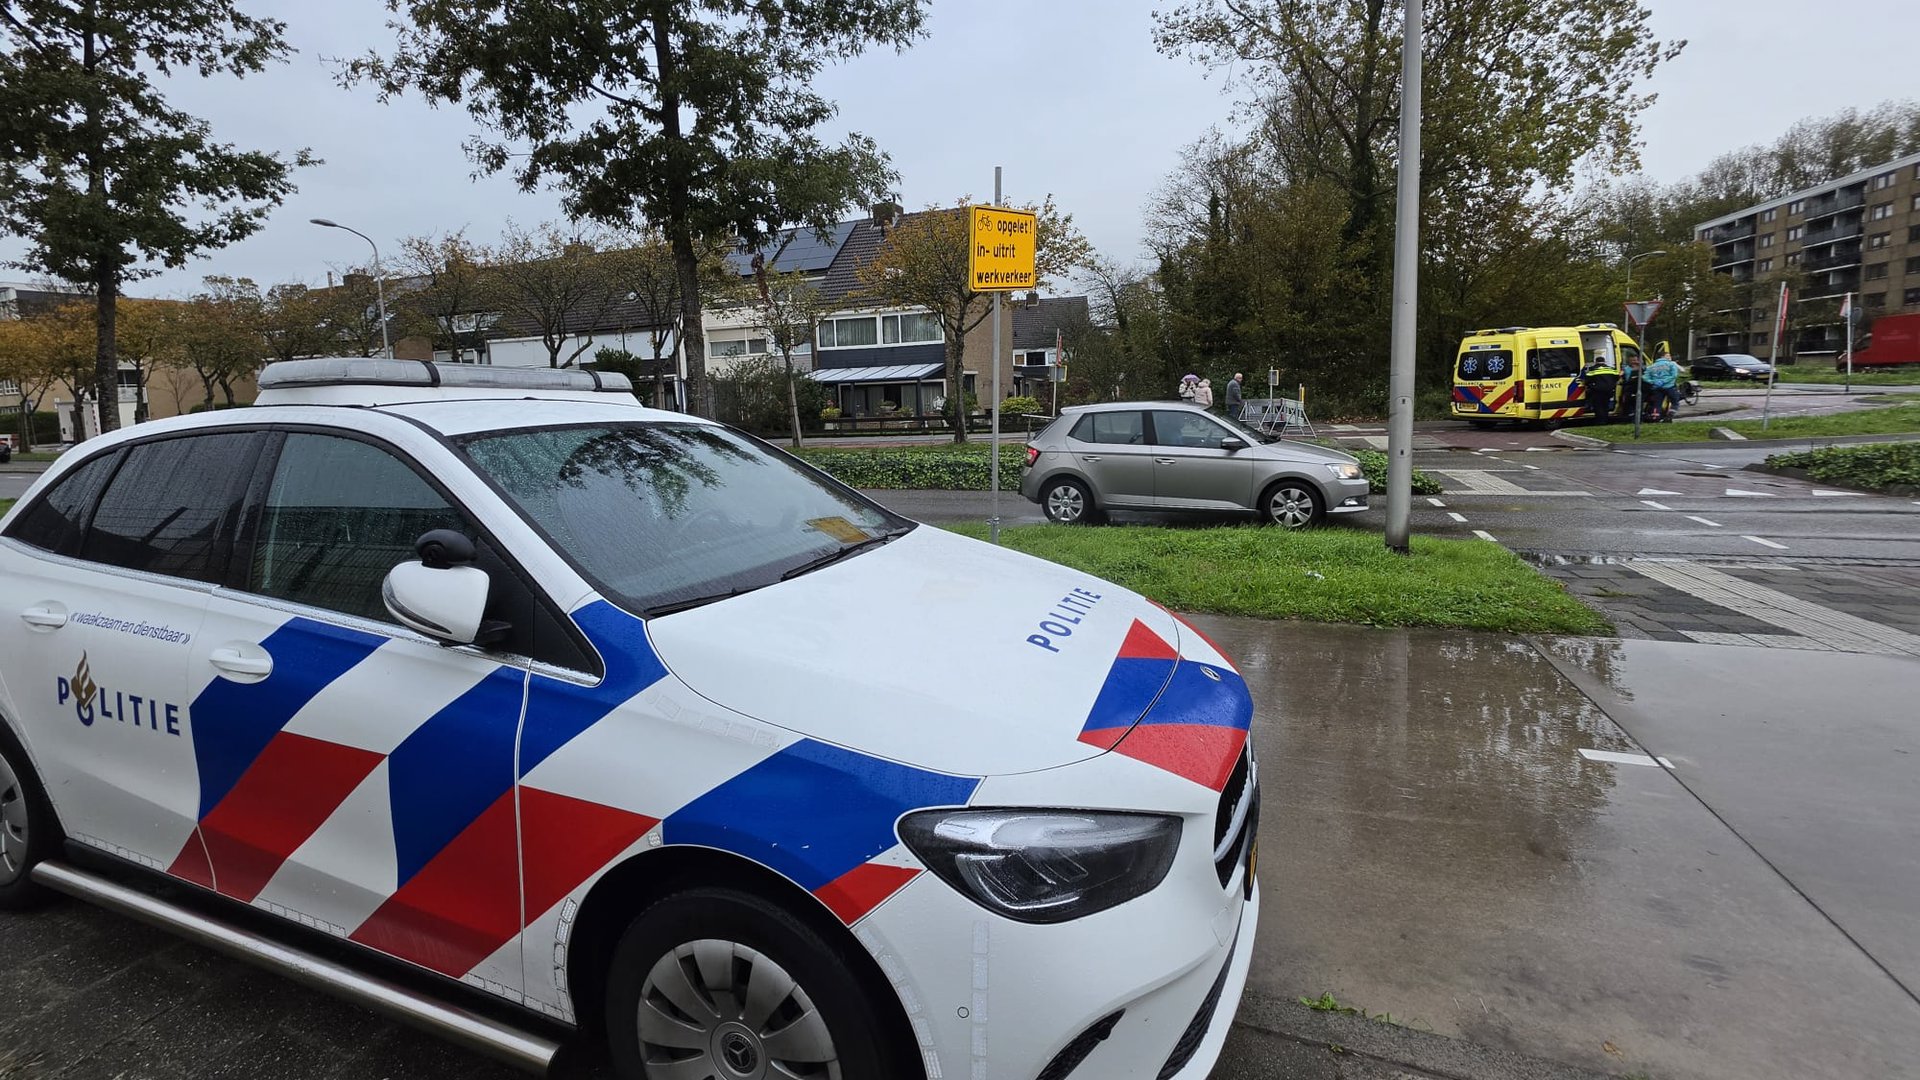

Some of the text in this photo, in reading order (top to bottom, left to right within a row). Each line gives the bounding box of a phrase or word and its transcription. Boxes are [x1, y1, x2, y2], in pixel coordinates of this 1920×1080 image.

[993, 243, 1016, 258] uitrit
[976, 268, 1032, 283] werkverkeer
[1025, 587, 1103, 654] POLITIE
[56, 675, 181, 737] POLITIE
